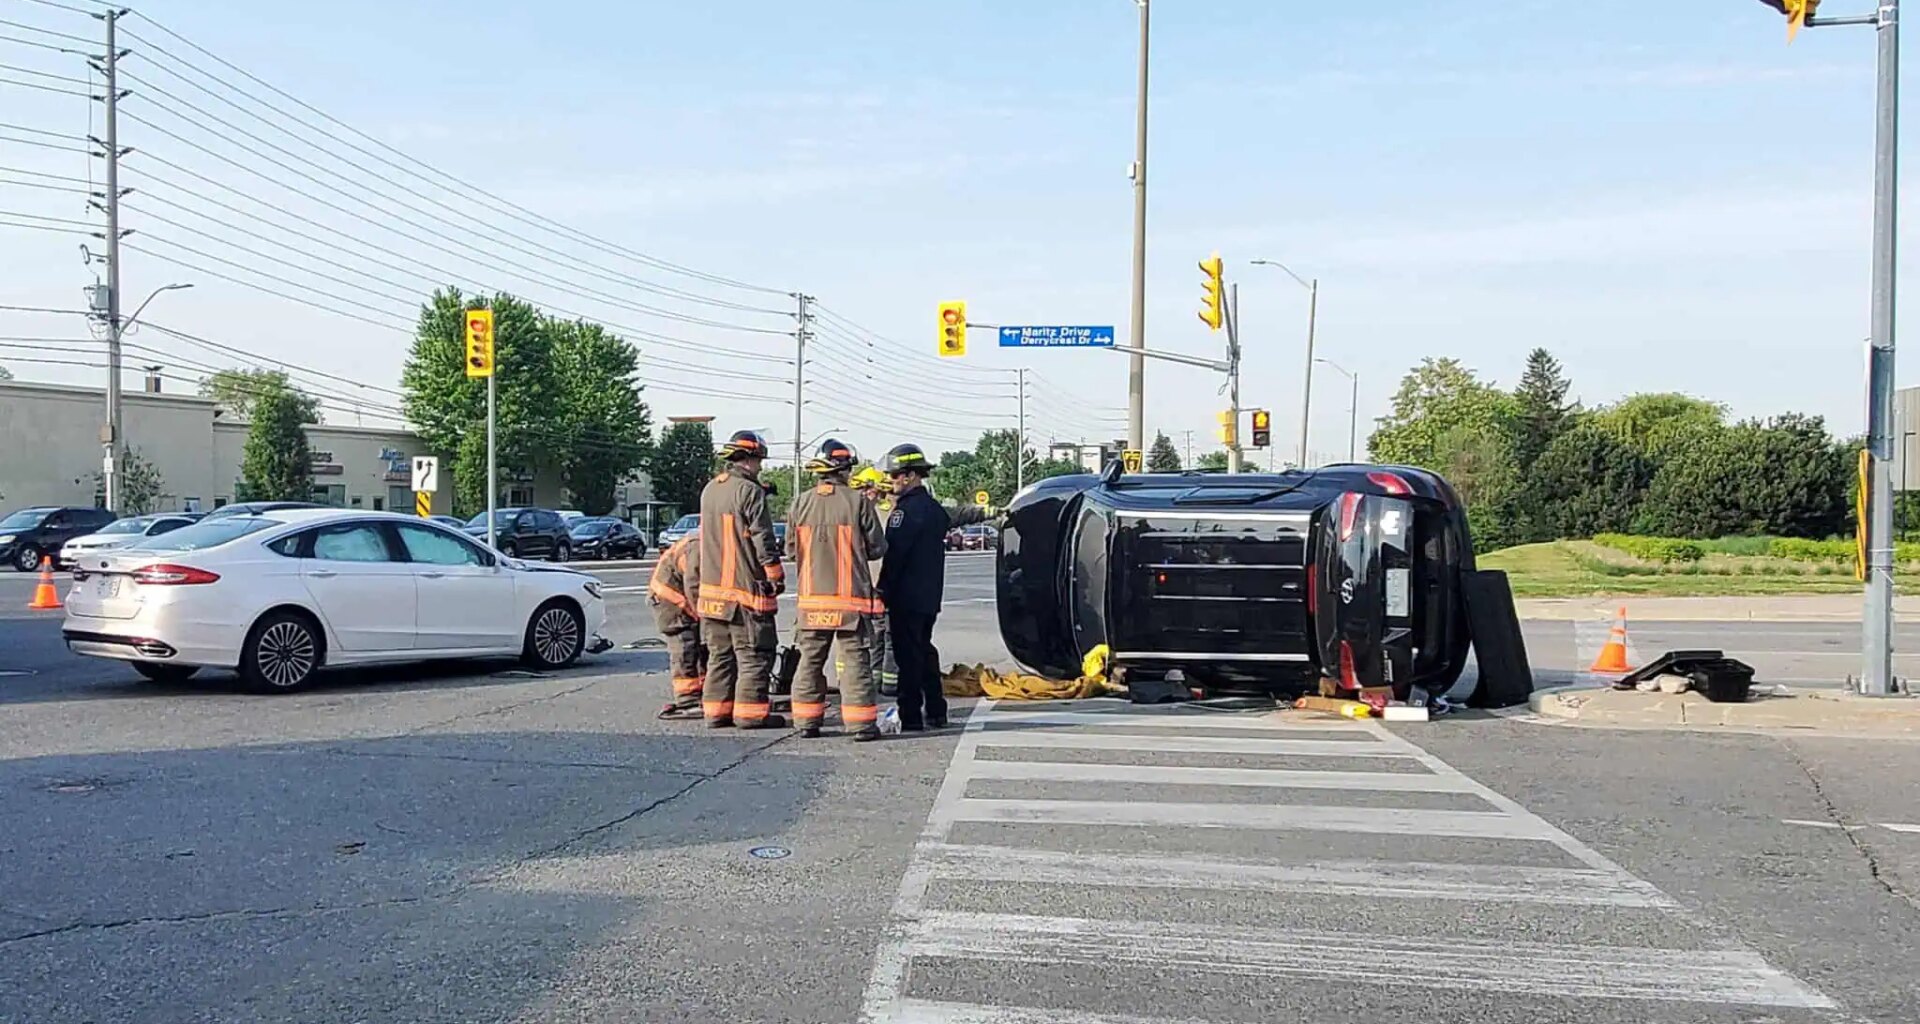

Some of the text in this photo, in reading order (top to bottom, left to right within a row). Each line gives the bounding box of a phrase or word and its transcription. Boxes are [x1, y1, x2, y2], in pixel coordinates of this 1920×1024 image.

[1021, 327, 1091, 338] Maritz Drive
[1020, 337, 1091, 346] Derrycrest Dr
